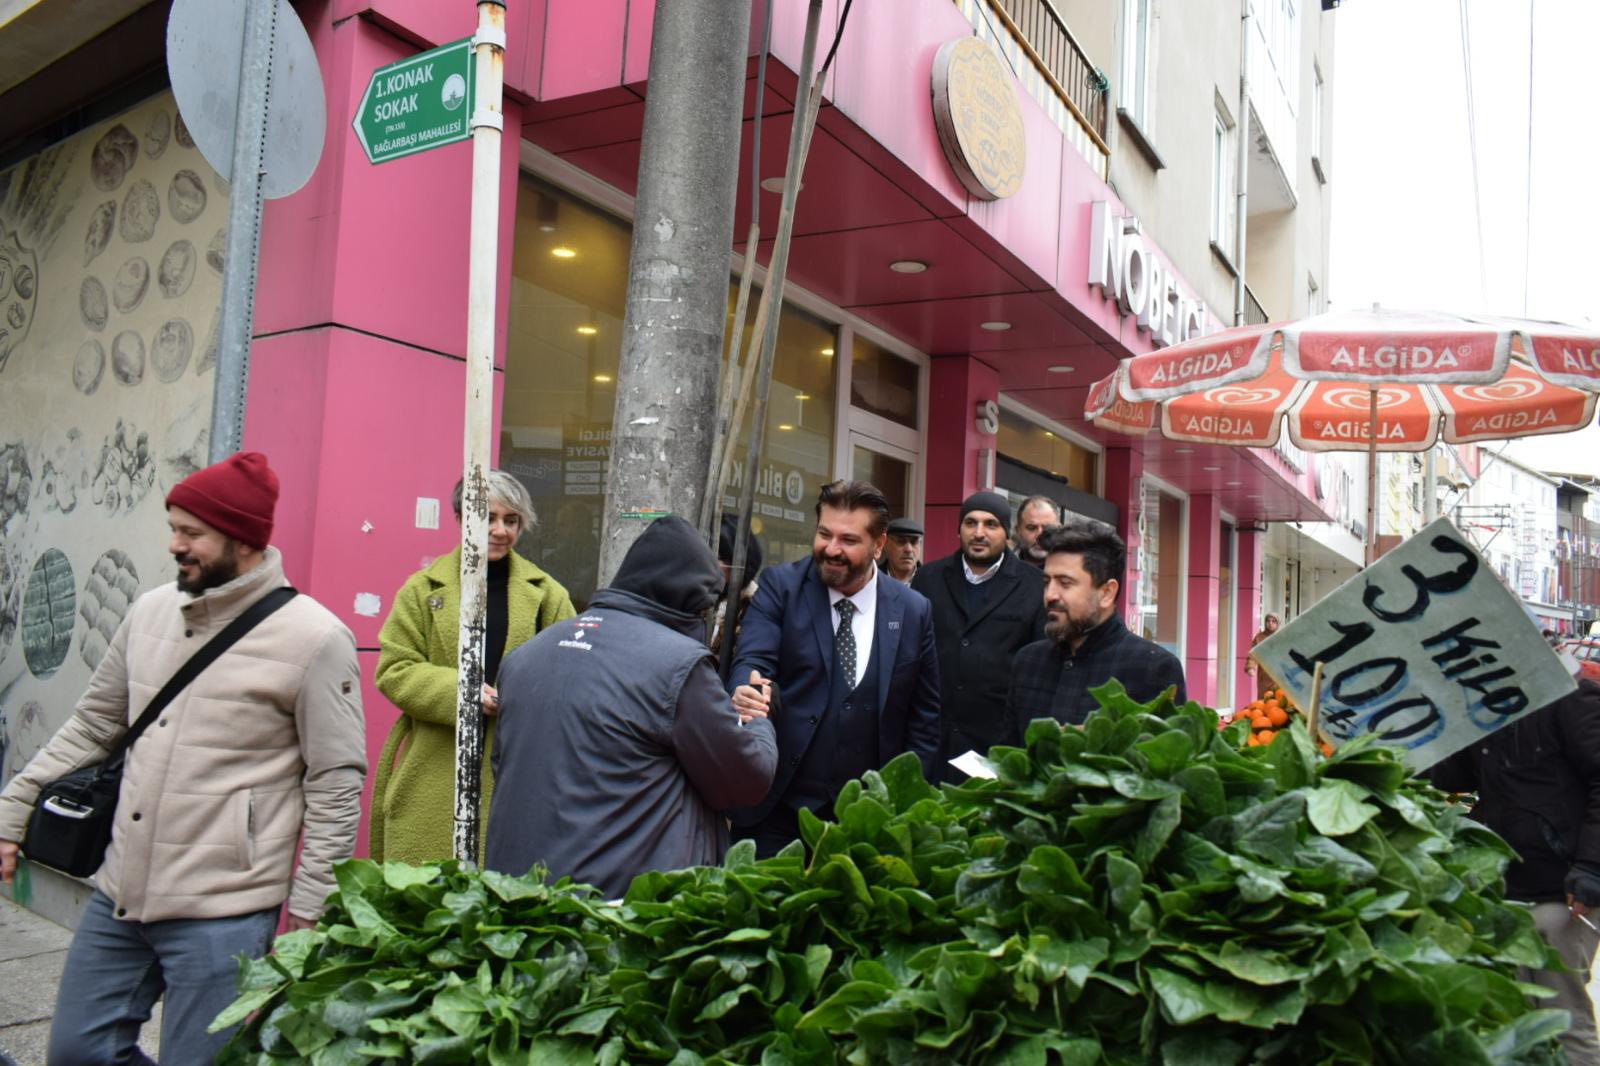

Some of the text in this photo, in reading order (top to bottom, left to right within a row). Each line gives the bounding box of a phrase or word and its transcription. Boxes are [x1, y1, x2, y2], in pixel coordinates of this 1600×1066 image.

[375, 63, 434, 98] 1.KONAK
[374, 93, 418, 123] SOKAK
[373, 134, 417, 154] BAĞLARBAŞI
[418, 118, 461, 142] MAHALLESİ
[1362, 533, 1479, 624] 3
[1289, 619, 1442, 740] 100
